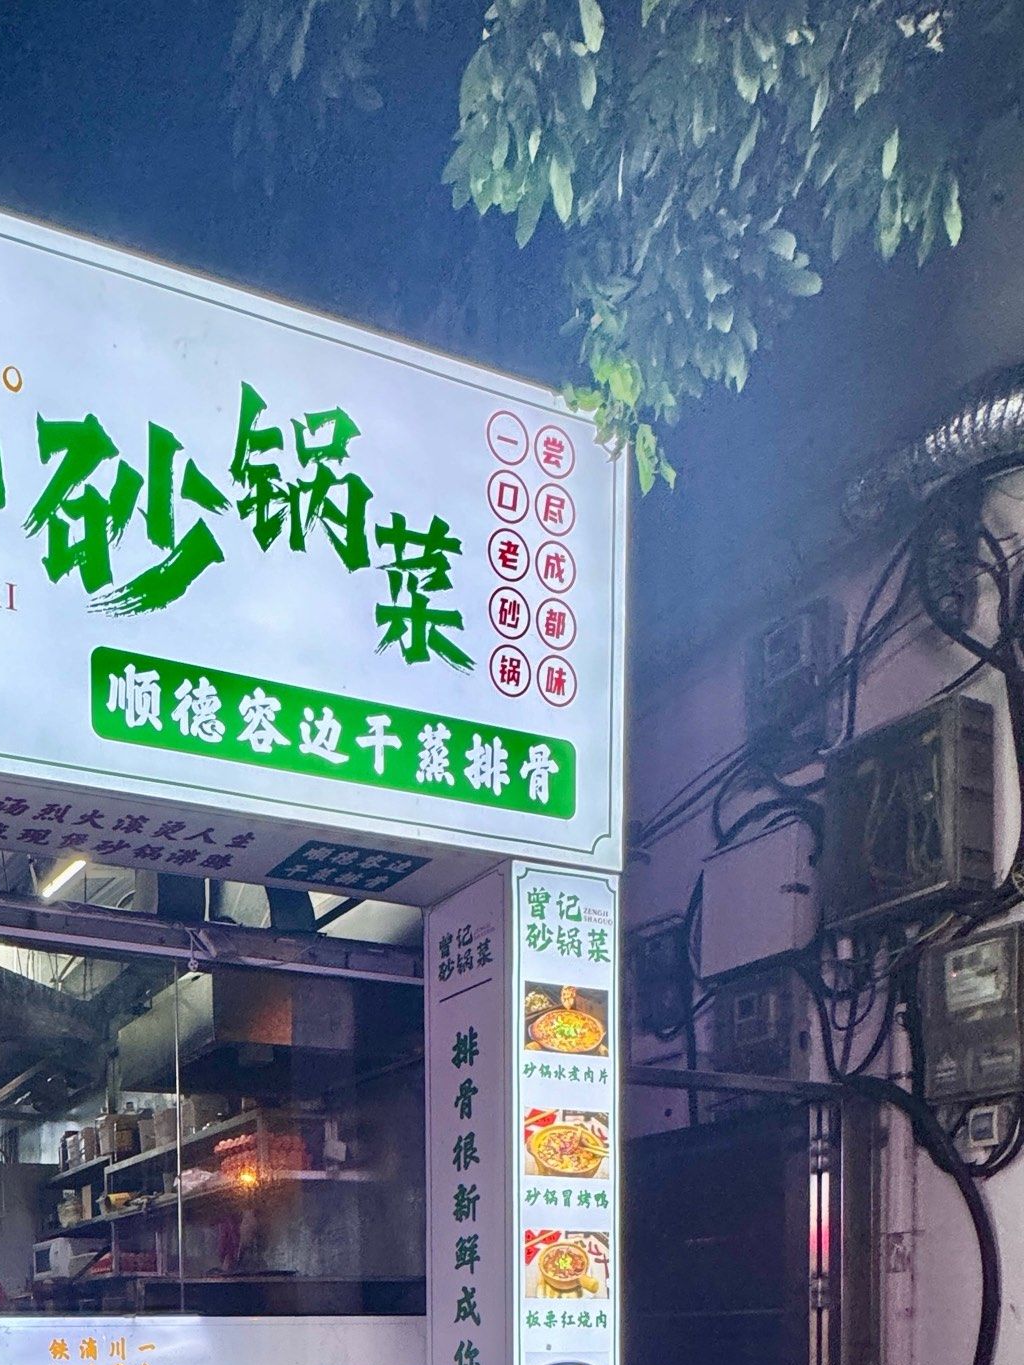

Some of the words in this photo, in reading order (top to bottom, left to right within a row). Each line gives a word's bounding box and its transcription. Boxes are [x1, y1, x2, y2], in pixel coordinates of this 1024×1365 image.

[492, 423, 527, 692] 一口老砂锅
[538, 431, 572, 701] 尝尽成都味
[106, 662, 561, 804] 顺德容边干蒸排骨
[527, 887, 582, 921] 曾记
[438, 937, 494, 982] 砂锅菜
[439, 924, 474, 959] 曾记
[526, 922, 611, 963] 砂锅菜
[522, 1061, 609, 1085] 砂锅水煮肉片
[524, 1187, 610, 1209] 砂锅冒烤鸭
[525, 1309, 608, 1329] 板栗红烧肉
